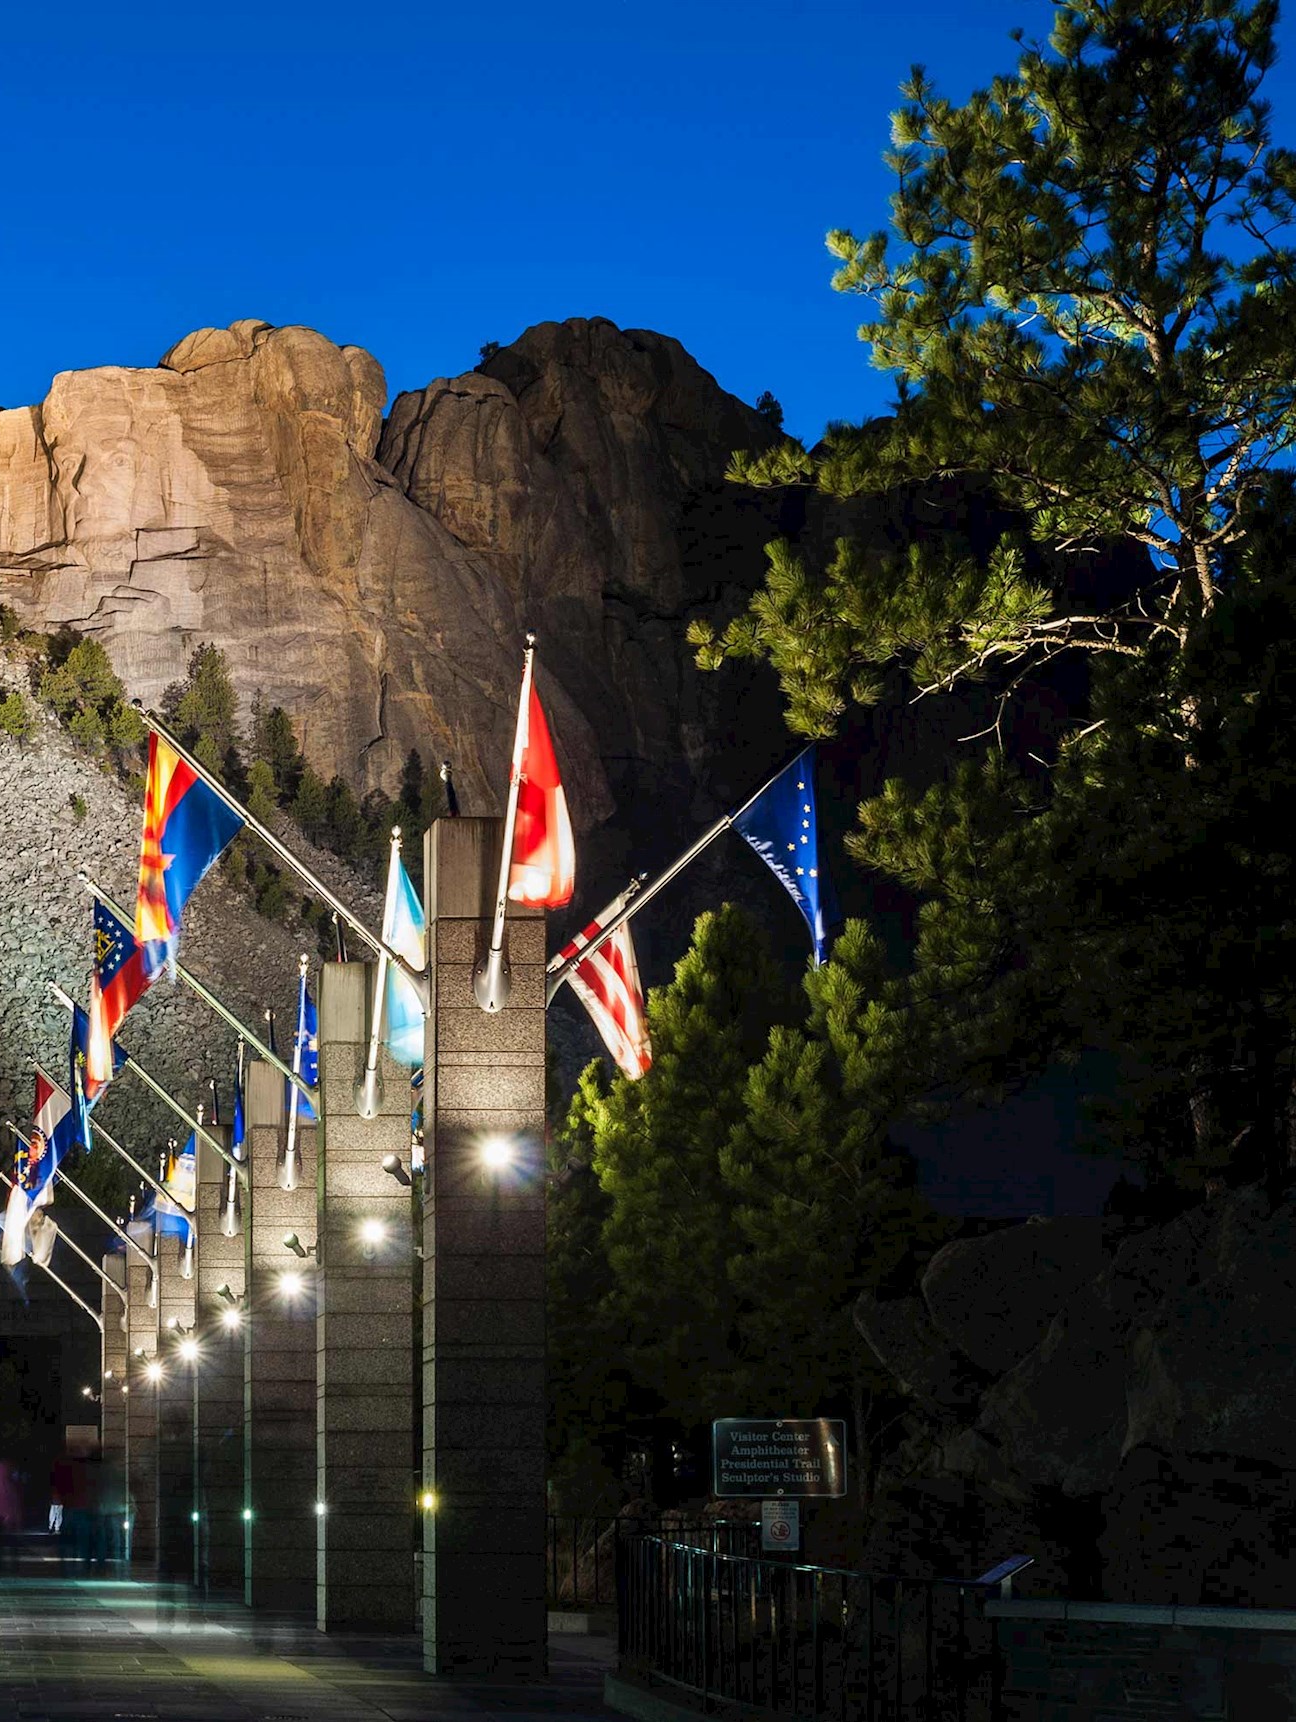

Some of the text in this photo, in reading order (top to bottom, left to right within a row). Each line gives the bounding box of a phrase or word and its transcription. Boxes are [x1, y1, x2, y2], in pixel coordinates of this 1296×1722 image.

[730, 1431, 810, 1441] Visitor Center
[731, 1445, 810, 1457] Amphitheater
[720, 1458, 821, 1469] Presidential Trail
[721, 1472, 820, 1484] Sculptor's Studio
